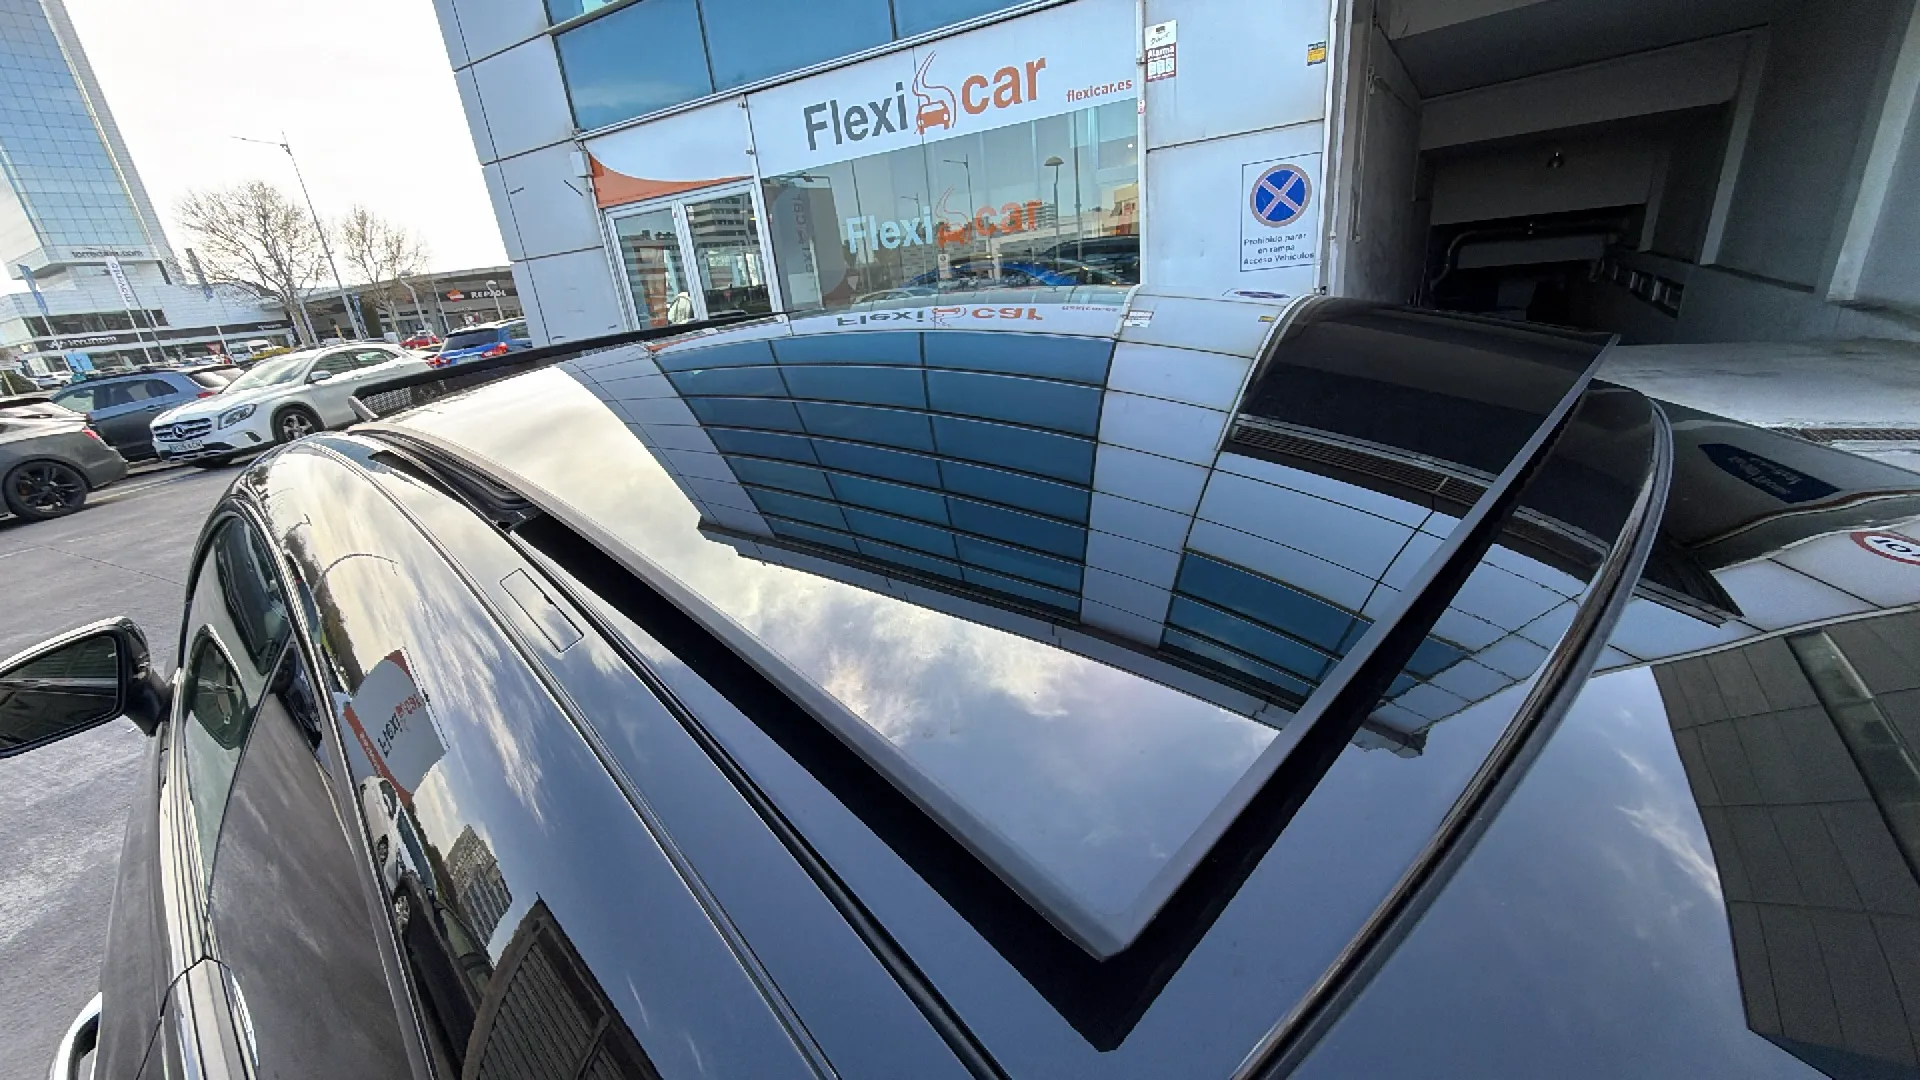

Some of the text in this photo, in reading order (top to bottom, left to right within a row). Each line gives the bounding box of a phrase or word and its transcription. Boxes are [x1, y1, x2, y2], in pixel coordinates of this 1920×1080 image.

[1066, 79, 1133, 102] flexicar.es
[803, 57, 1046, 150] Flexi car
[846, 199, 1043, 254] Flexi car
[1243, 233, 1307, 247] Prohibido parar
[1257, 244, 1295, 255] en rampa
